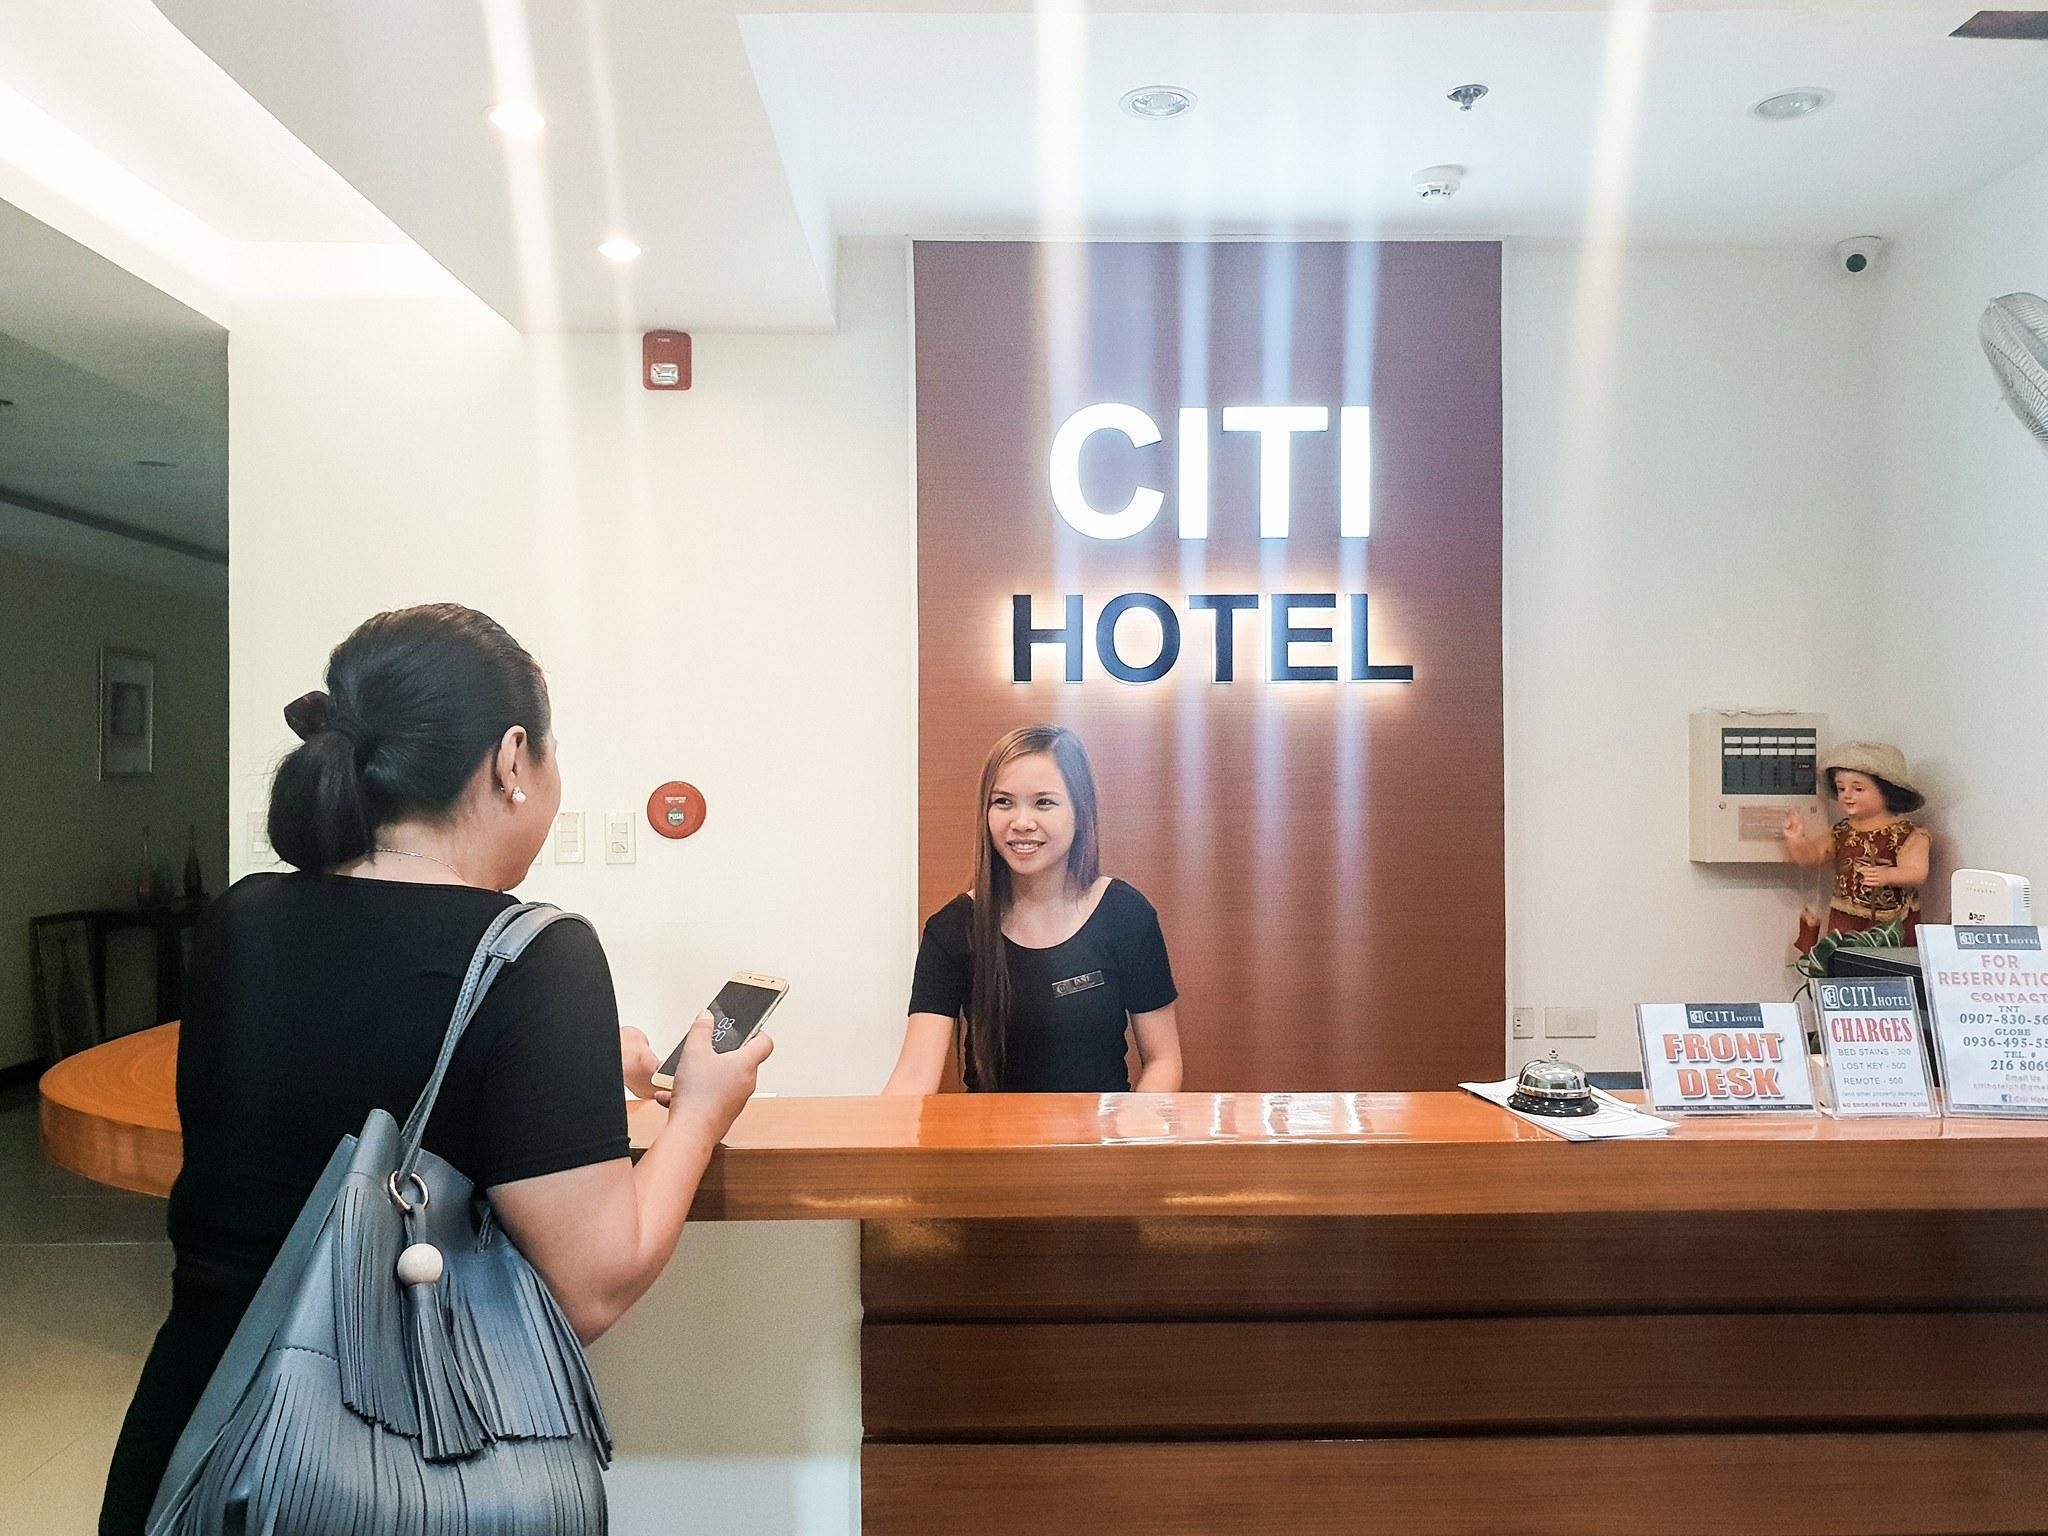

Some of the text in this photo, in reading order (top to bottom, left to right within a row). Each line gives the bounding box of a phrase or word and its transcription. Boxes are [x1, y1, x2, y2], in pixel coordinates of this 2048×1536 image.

[1049, 402, 1370, 539] CITI
[1012, 592, 1413, 684] HOTEL
[1975, 933, 2009, 944] CITI
[1981, 954, 2018, 968] FOR
[1840, 986, 1878, 1007] CITI
[1877, 996, 1910, 1007] HOTEL
[1970, 992, 2048, 1004] CONTACT
[1998, 1005, 2020, 1013] TNT
[1704, 1010, 1735, 1023] CITI
[1831, 1017, 1912, 1043] CHARGES
[1994, 1028, 2031, 1036] GLOBE
[1662, 1032, 1783, 1063] FRONT
[1838, 1048, 1857, 1056] BED
[1859, 1048, 1889, 1056] STAINS
[1841, 1062, 1864, 1070] LOST
[1867, 1062, 1882, 1070] KEY
[1891, 1062, 1906, 1070] 500
[1990, 1060, 2014, 1071] 216
[1677, 1067, 1784, 1099] DESK
[1843, 1077, 1880, 1085] REMOTE
[1889, 1077, 1903, 1085] 500
